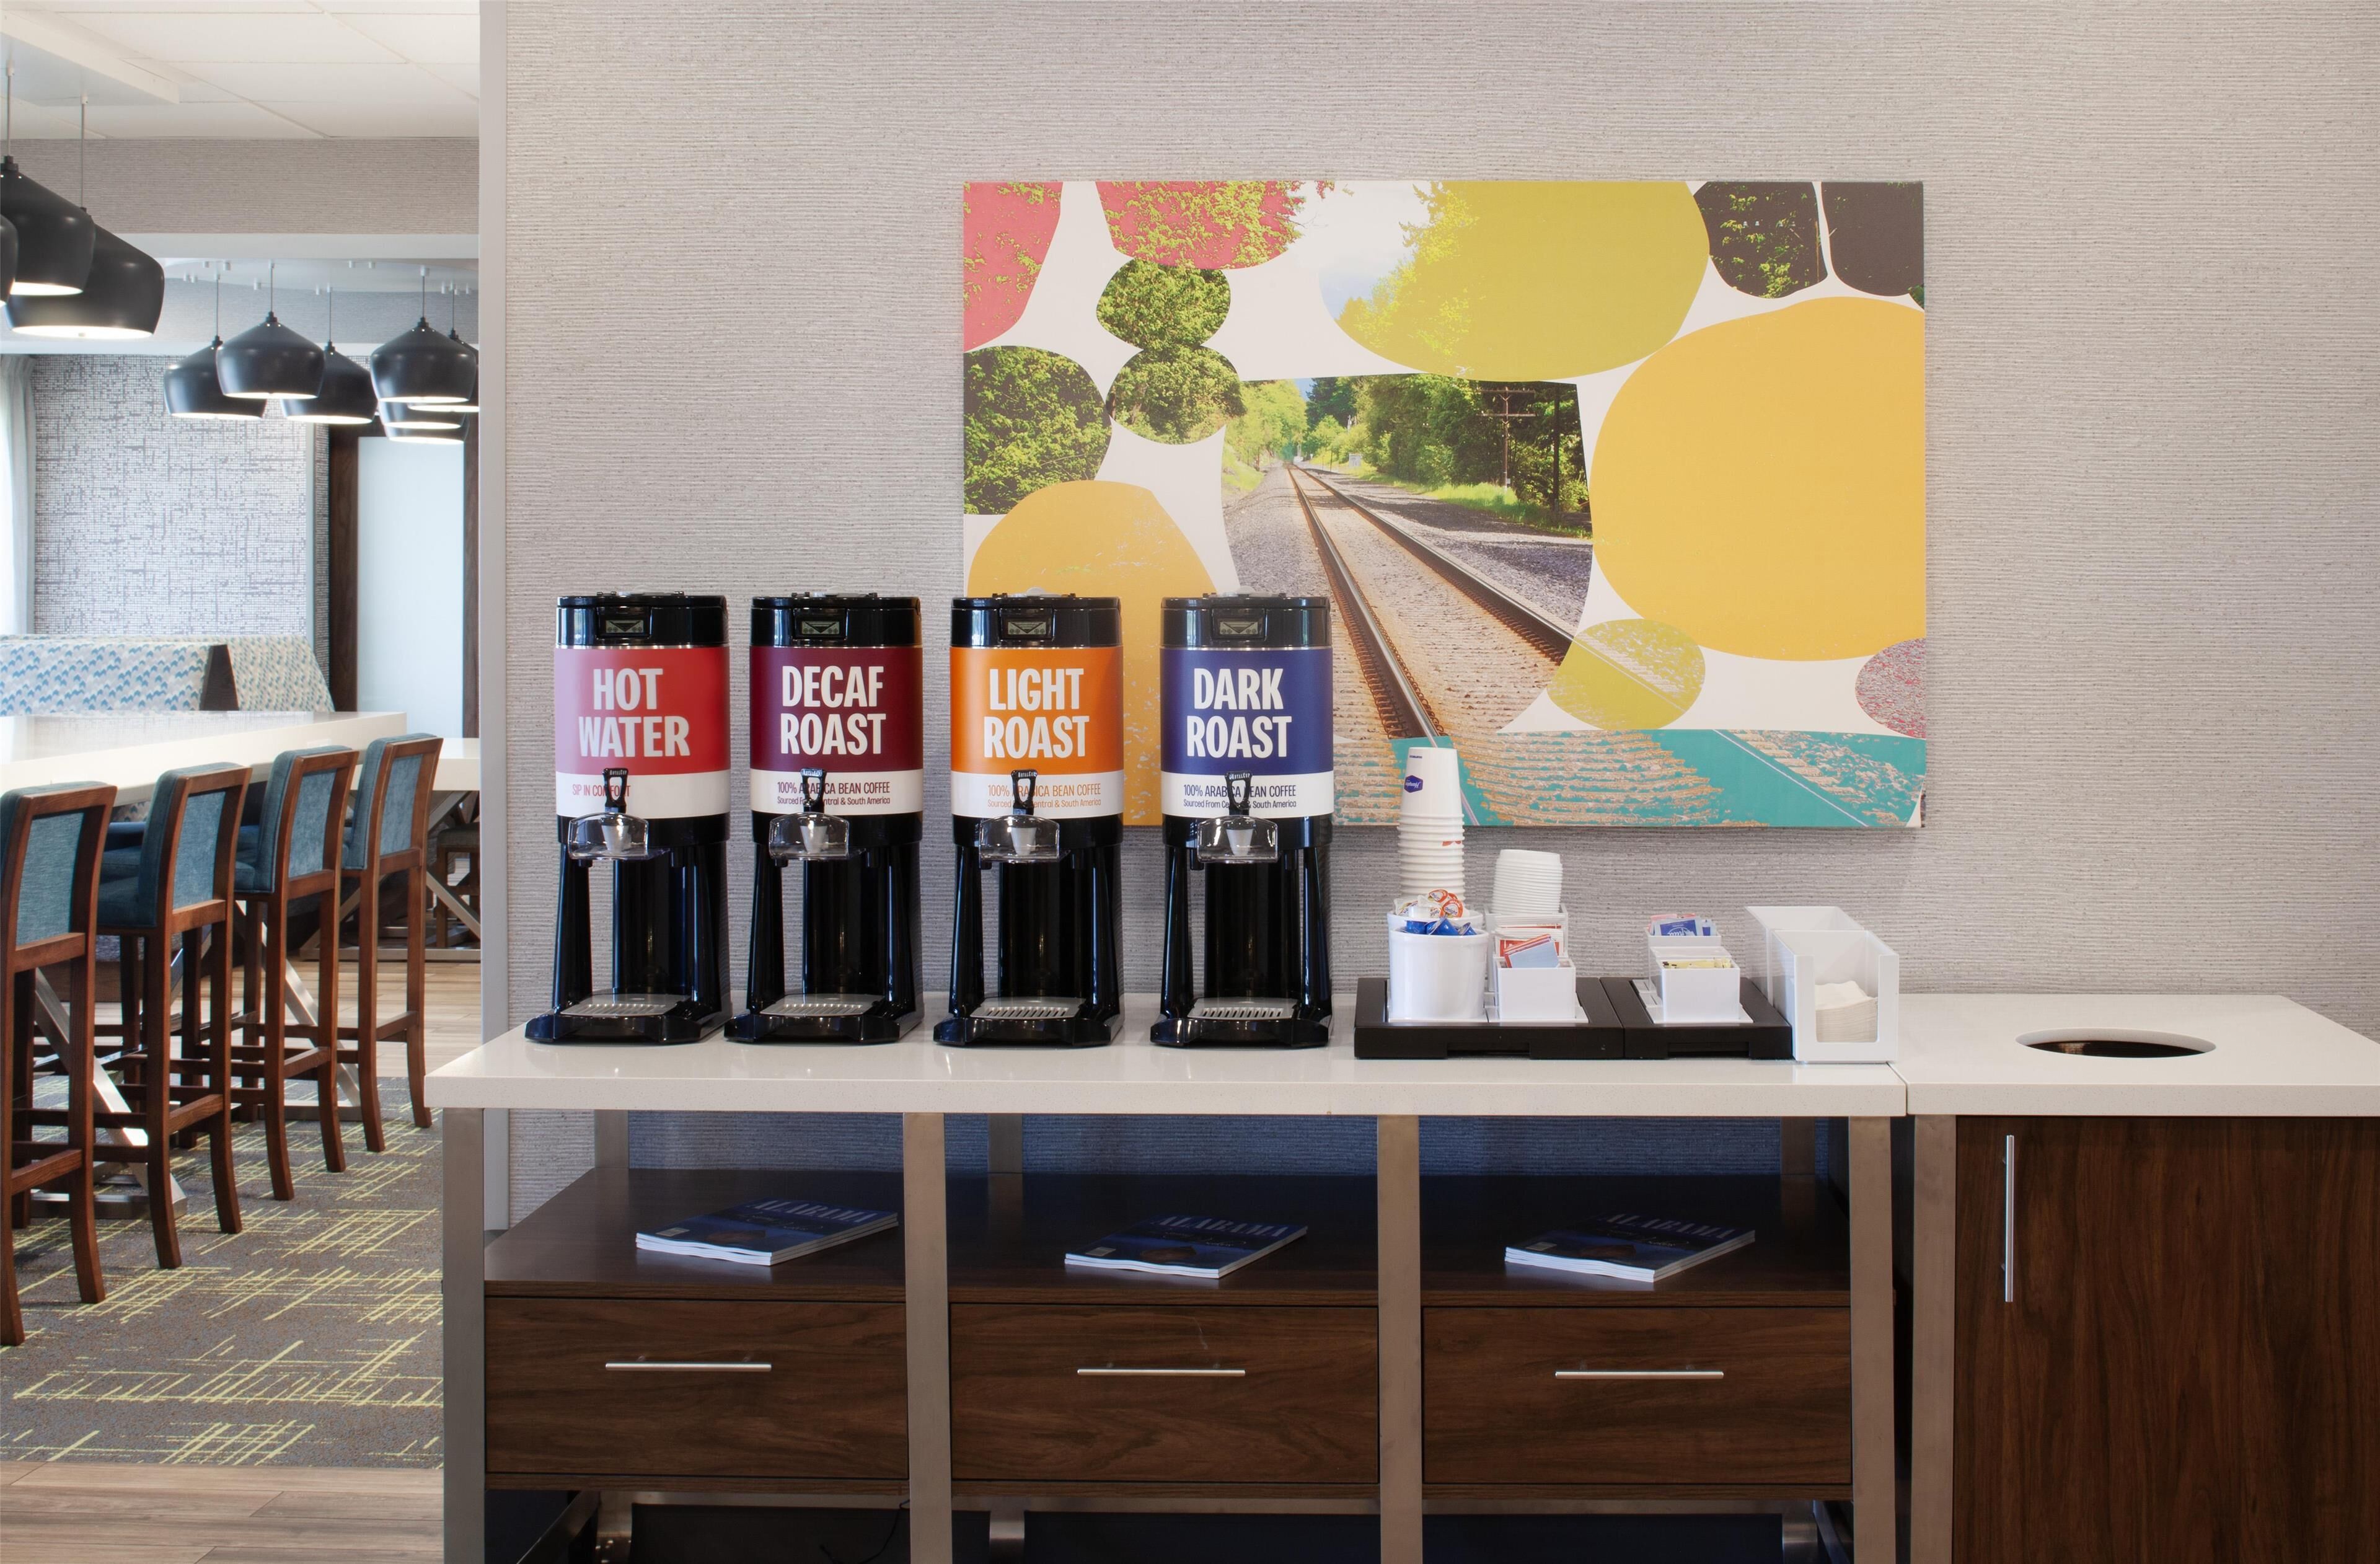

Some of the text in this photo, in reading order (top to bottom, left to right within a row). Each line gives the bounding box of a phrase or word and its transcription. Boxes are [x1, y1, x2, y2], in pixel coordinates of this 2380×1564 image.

[593, 668, 664, 711] HOT
[781, 665, 884, 709] DECAF
[989, 668, 1084, 711] LIGHT
[1193, 668, 1284, 711] DARK
[578, 715, 691, 758] WATER
[780, 713, 887, 756] ROAST
[983, 715, 1090, 758] ROAST
[1186, 715, 1293, 758] ROAST
[572, 784, 581, 795] SIP
[584, 785, 591, 796] IN
[777, 782, 797, 793] 100%
[839, 782, 862, 794] BEAN
[863, 781, 891, 794] COFFEE
[777, 796, 798, 805] Sourced
[823, 797, 839, 805] ntral
[840, 797, 846, 805] &
[847, 797, 866, 805] South
[867, 796, 891, 805] America
[987, 799, 1011, 808] Sourced
[1034, 800, 1053, 808] entral
[1055, 800, 1061, 808] &
[1061, 799, 1079, 808] South
[1080, 798, 1101, 807] America
[988, 784, 1010, 797] 100%
[1052, 785, 1075, 797] BEAN
[1077, 783, 1101, 796] COFFEE
[1184, 784, 1203, 797] 100%
[1244, 785, 1266, 797] EAN
[1269, 784, 1297, 797] COFFEE
[1183, 799, 1205, 808] Sourced
[1205, 800, 1220, 808] From
[1253, 800, 1271, 809] South
[1272, 799, 1297, 808] America
[1150, 1216, 1289, 1237] ALABAMA
